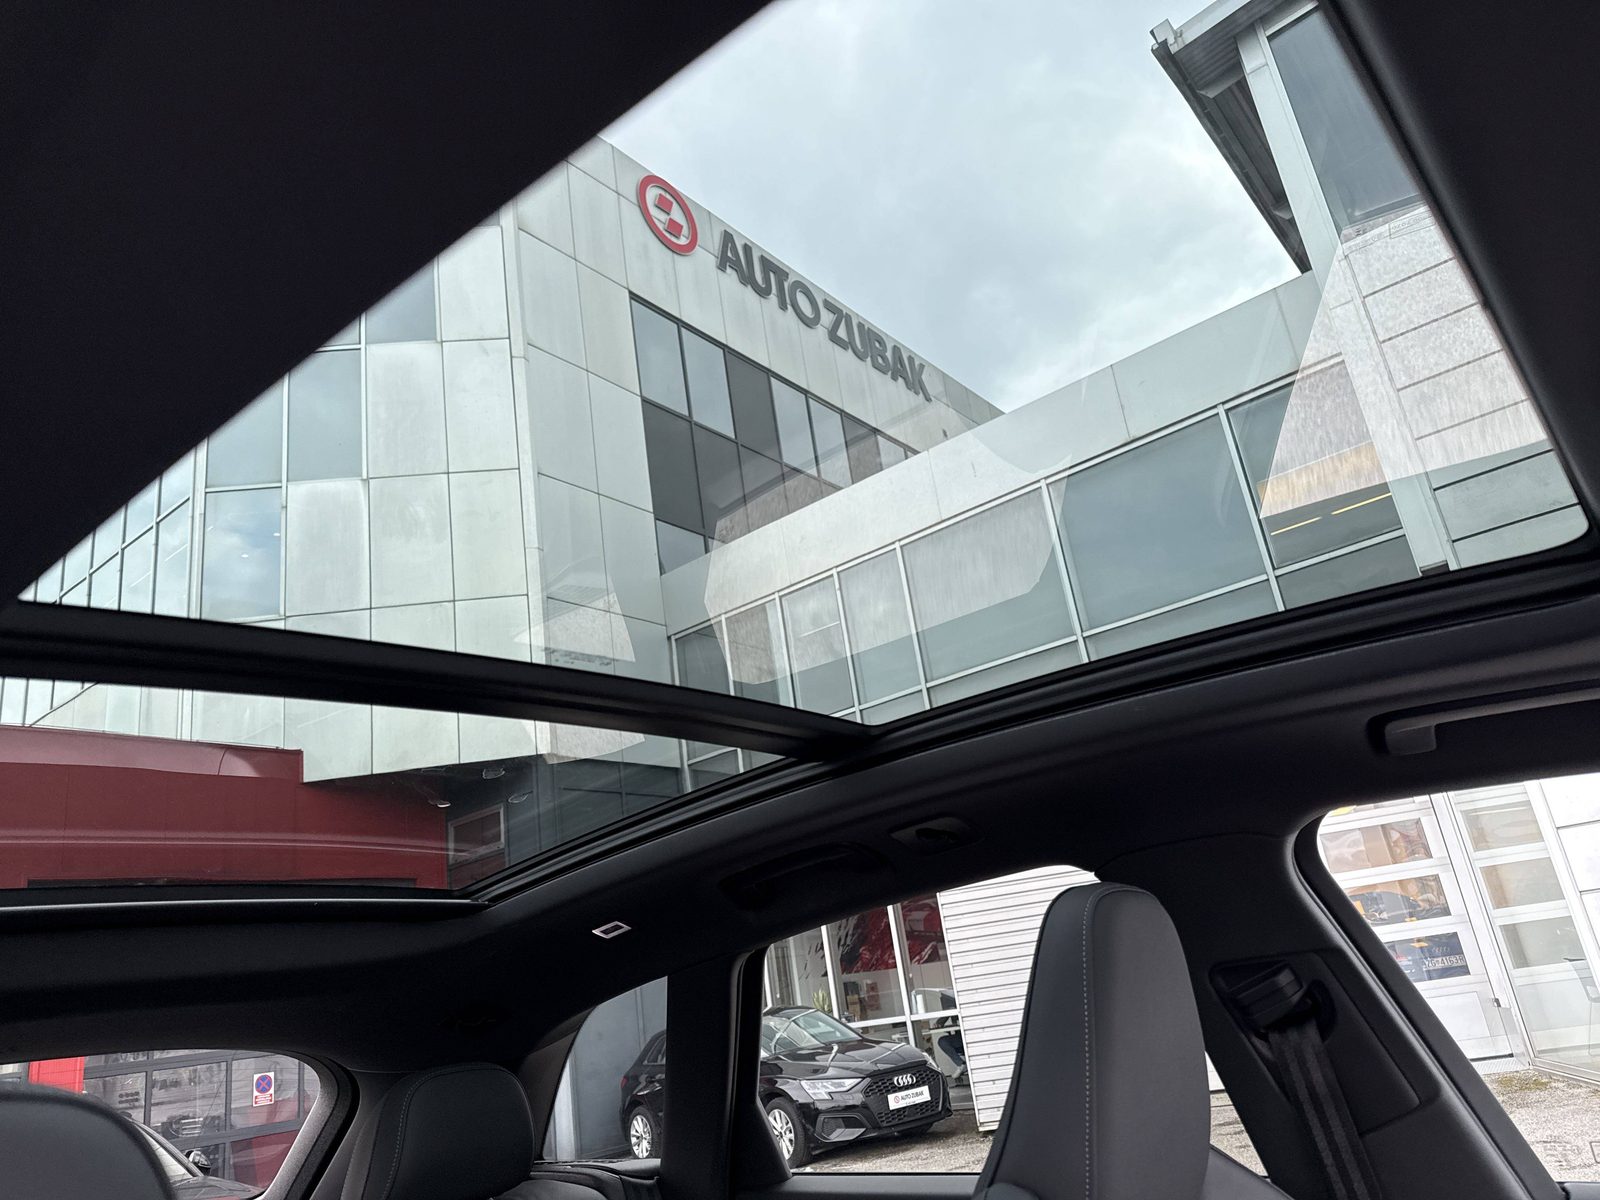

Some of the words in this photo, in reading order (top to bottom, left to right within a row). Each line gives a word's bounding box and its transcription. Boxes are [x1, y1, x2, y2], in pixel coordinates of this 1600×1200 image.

[717, 229, 821, 329] AUTO
[823, 298, 932, 402] ZUBAK
[900, 1093, 912, 1101] AUTO
[911, 1090, 924, 1099] ZUBAK
